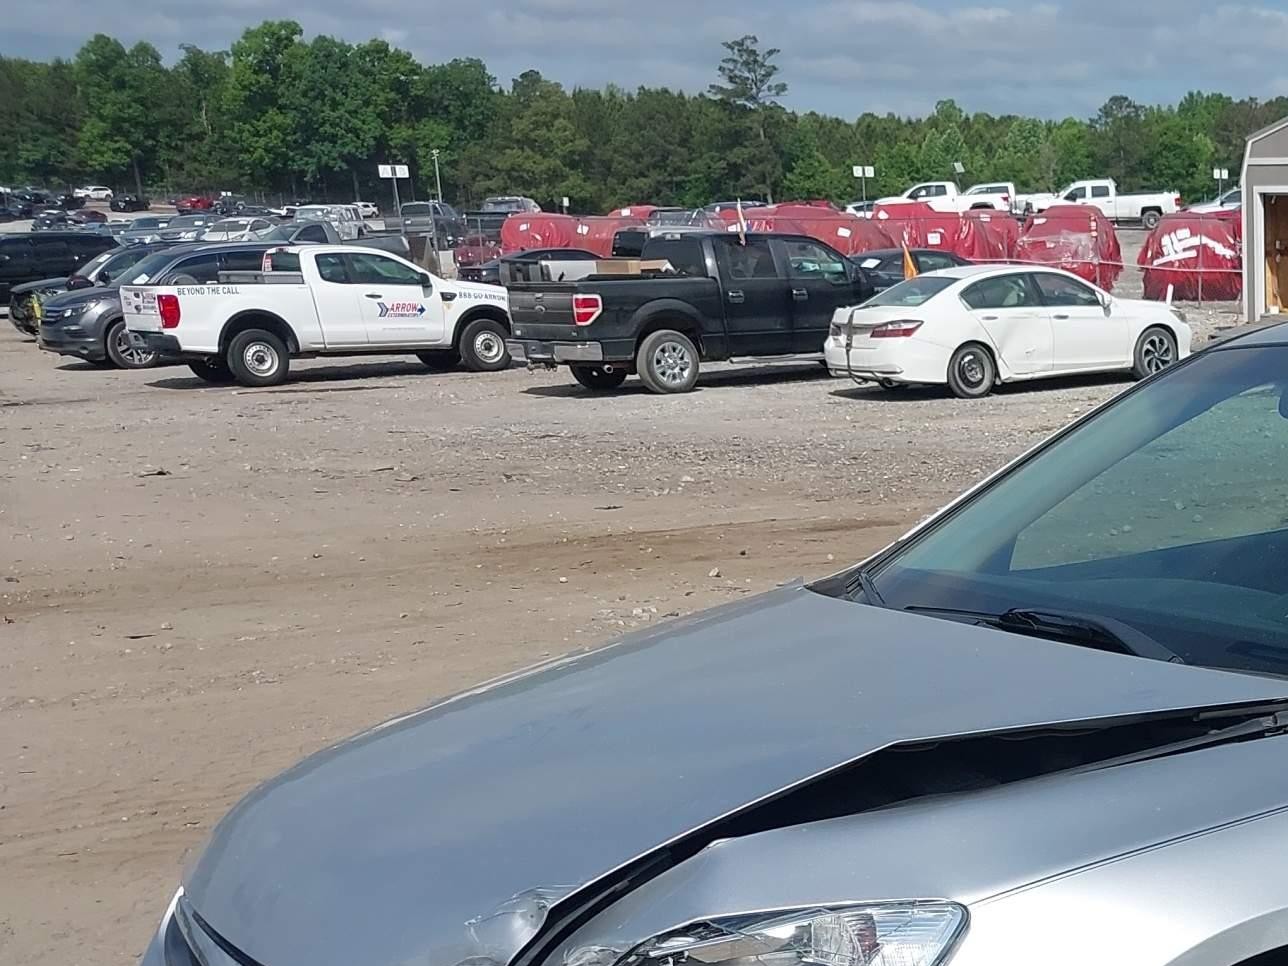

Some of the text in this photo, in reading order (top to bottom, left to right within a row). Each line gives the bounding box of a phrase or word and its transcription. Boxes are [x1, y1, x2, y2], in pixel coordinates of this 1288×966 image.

[177, 286, 240, 296] BEYOND THE CALL
[390, 302, 418, 313] ARROW
